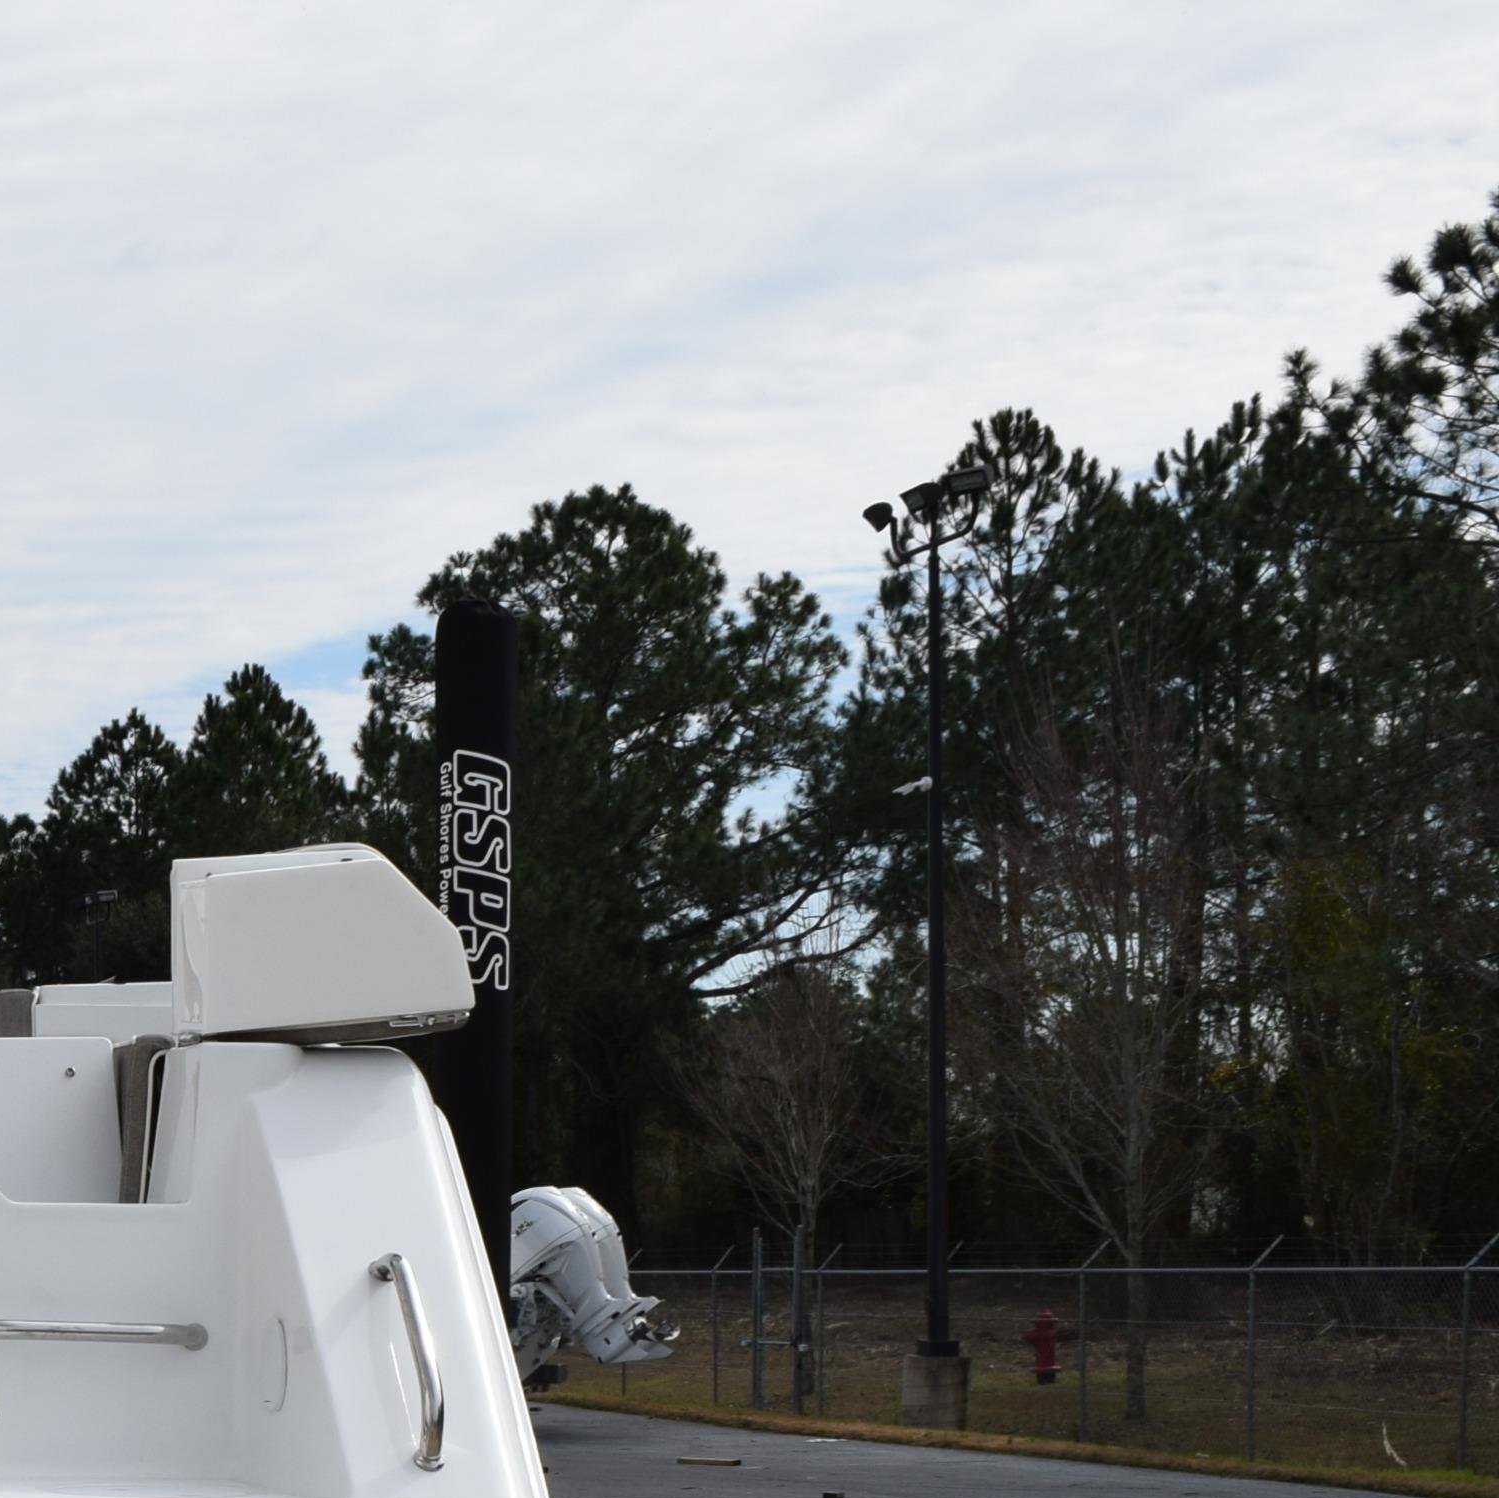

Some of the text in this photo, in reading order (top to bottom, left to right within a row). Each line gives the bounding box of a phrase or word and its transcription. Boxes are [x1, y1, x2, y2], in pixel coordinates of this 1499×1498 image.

[439, 761, 453, 919] Gulf Shores Powe
[453, 749, 512, 991] GSPS
